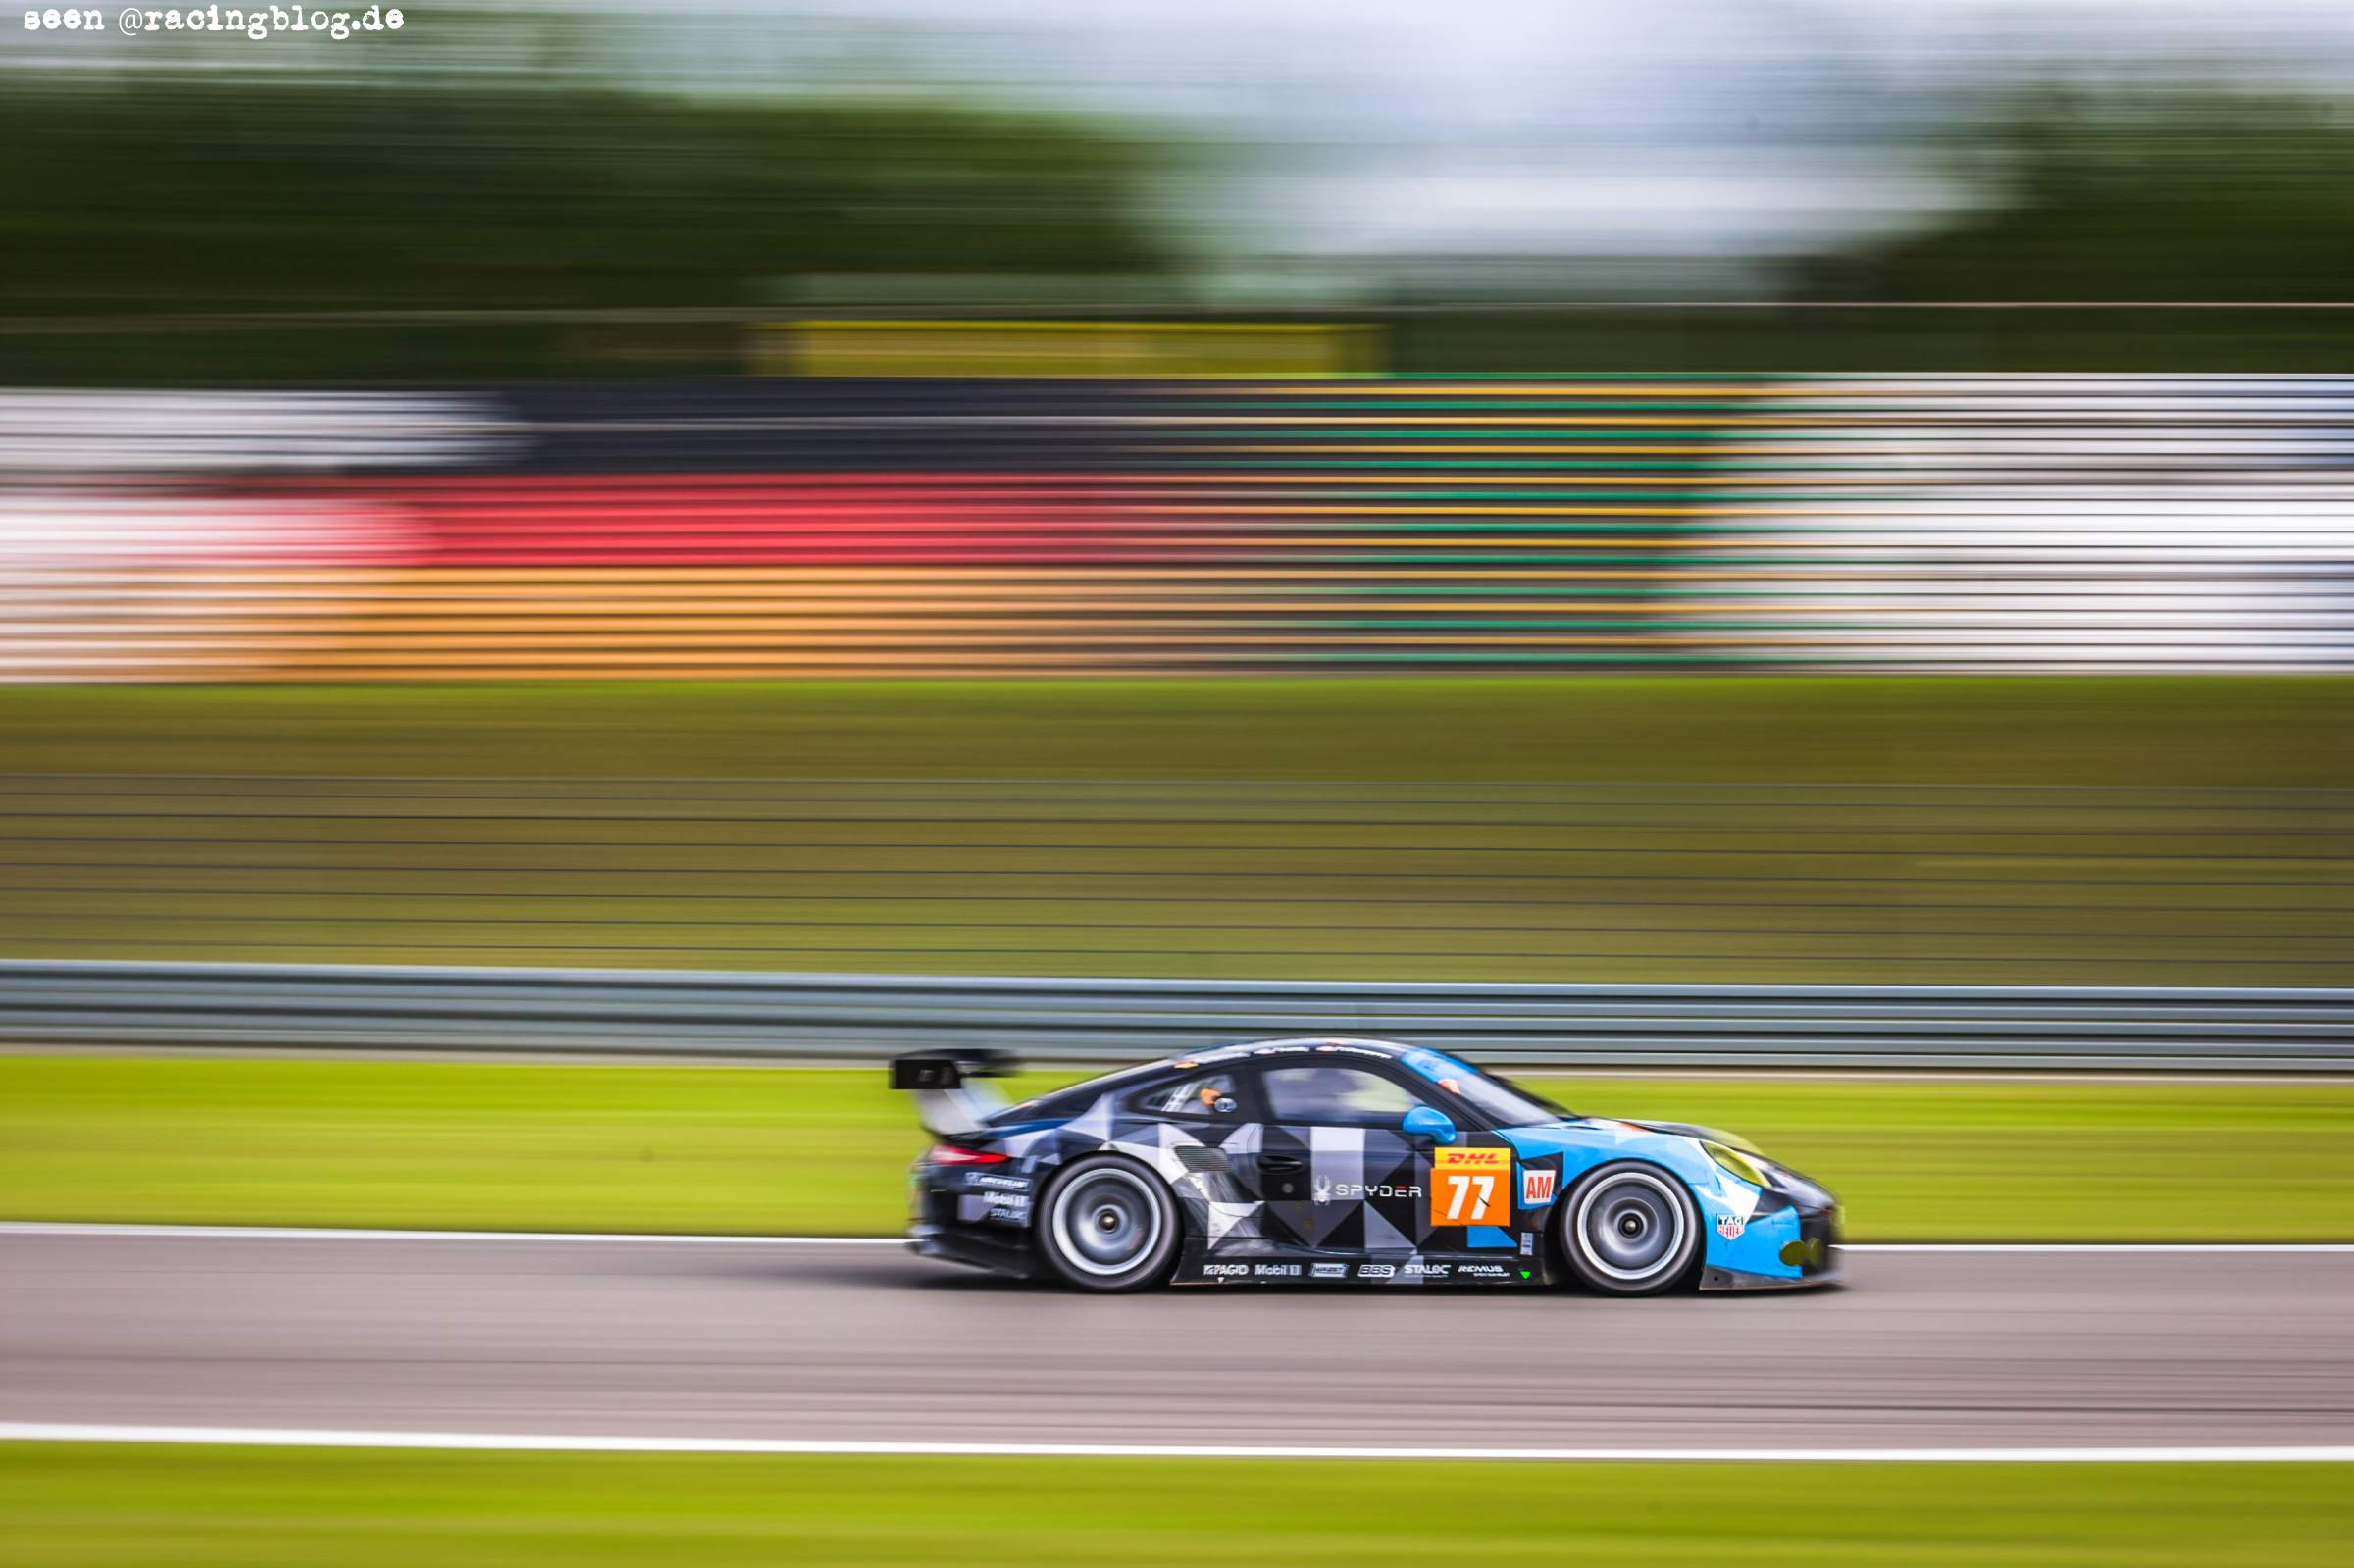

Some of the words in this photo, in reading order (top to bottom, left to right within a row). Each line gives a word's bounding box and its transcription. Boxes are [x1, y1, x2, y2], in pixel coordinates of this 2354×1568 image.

[1447, 1153, 1500, 1164] DHL
[1335, 1184, 1422, 1198] SPYDER
[1525, 1177, 1552, 1199] AM
[1447, 1176, 1495, 1220] 77
[1719, 1216, 1743, 1225] TAG
[1254, 1264, 1287, 1275] Mobil
[1358, 1265, 1395, 1277] BBS
[1405, 1265, 1451, 1275] STALOC
